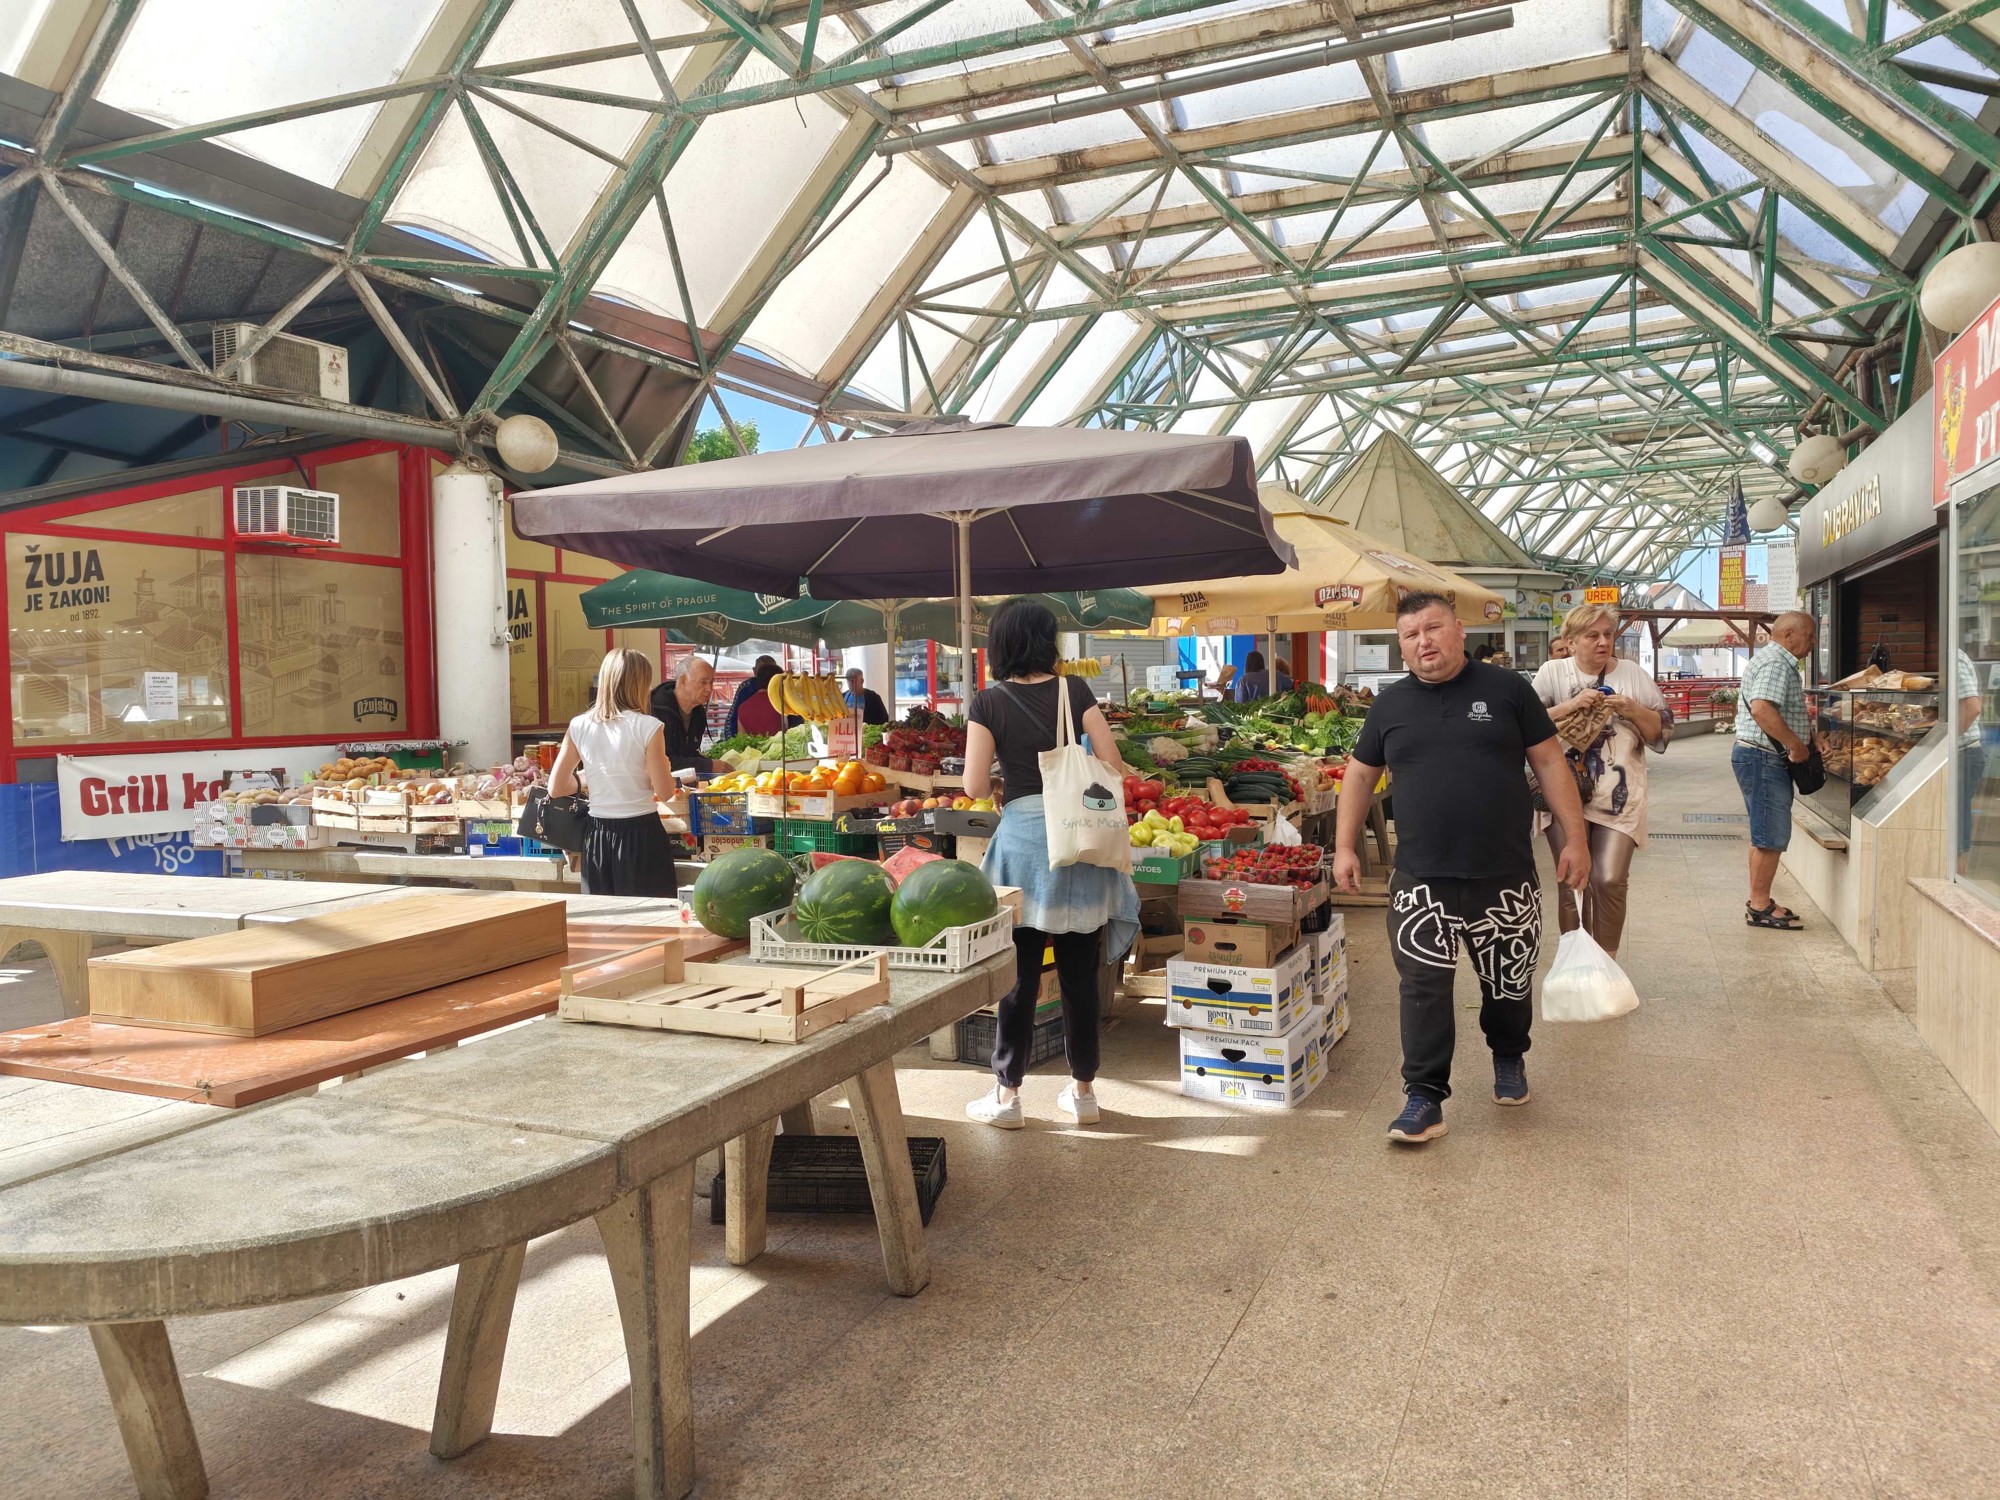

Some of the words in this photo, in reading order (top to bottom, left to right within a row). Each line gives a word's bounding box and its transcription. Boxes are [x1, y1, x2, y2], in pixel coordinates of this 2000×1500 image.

[1822, 473, 1881, 549] DUBRAVICA
[25, 544, 105, 589] ŽUJA
[24, 593, 43, 613] JE
[49, 586, 110, 609] ZAKON!
[507, 587, 529, 621] JA
[600, 606, 622, 617] THE
[625, 601, 657, 614] SPIRIT
[660, 600, 673, 609] OF
[676, 594, 717, 607] PRAGUE
[1722, 597, 1741, 605] VESTE
[70, 612, 80, 622] od
[80, 775, 169, 817] Grill
[711, 837, 748, 847] undación
[1132, 865, 1162, 874] MATOES
[1193, 966, 1227, 975] PREMIUM
[1228, 969, 1248, 977] PACK
[1207, 1010, 1234, 1025] BONITA
[1205, 1036, 1239, 1045] PREMIUM
[1241, 1039, 1260, 1047] PACK
[1220, 1080, 1247, 1095] BONITA
